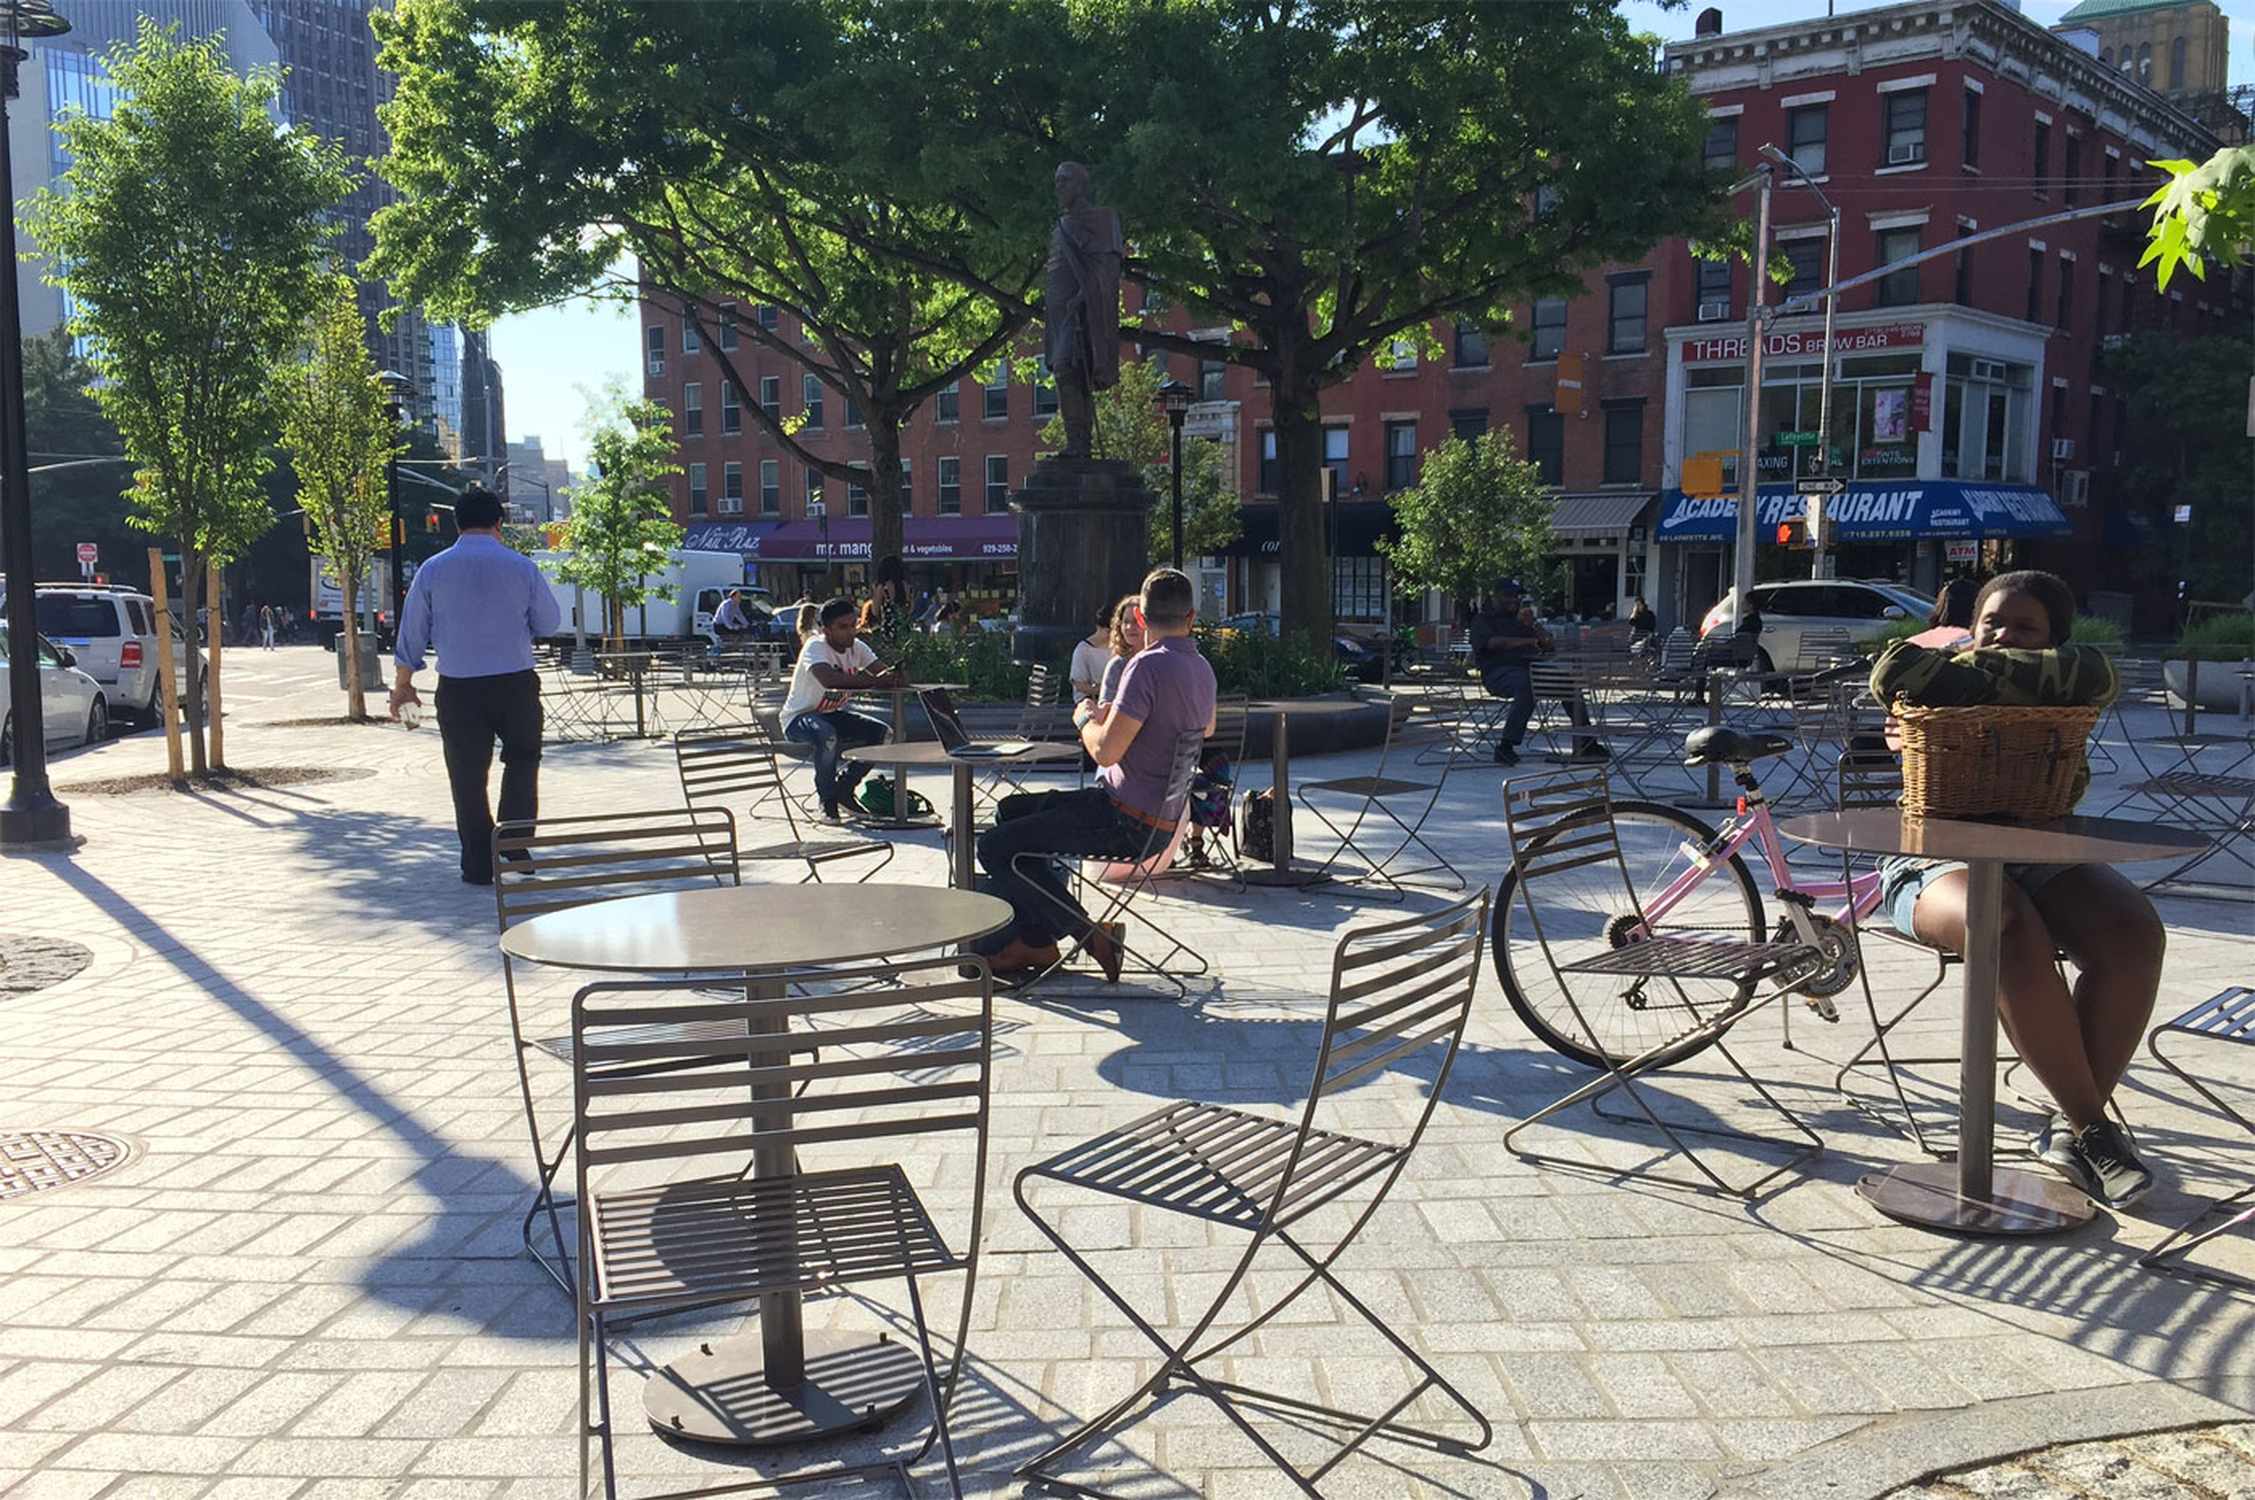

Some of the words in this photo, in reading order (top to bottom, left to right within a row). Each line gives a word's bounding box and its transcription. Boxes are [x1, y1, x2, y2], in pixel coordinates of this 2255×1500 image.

[1694, 334, 1801, 360] THREDS
[1806, 336, 1853, 353] BRW
[1855, 334, 1887, 349] BAR
[1757, 456, 1788, 468] AXING
[1664, 496, 1768, 527] ACADEY
[1763, 490, 1924, 524] RESAURANT
[816, 543, 836, 555] mr.
[840, 543, 872, 560] mang
[1949, 546, 1976, 556] ATM
